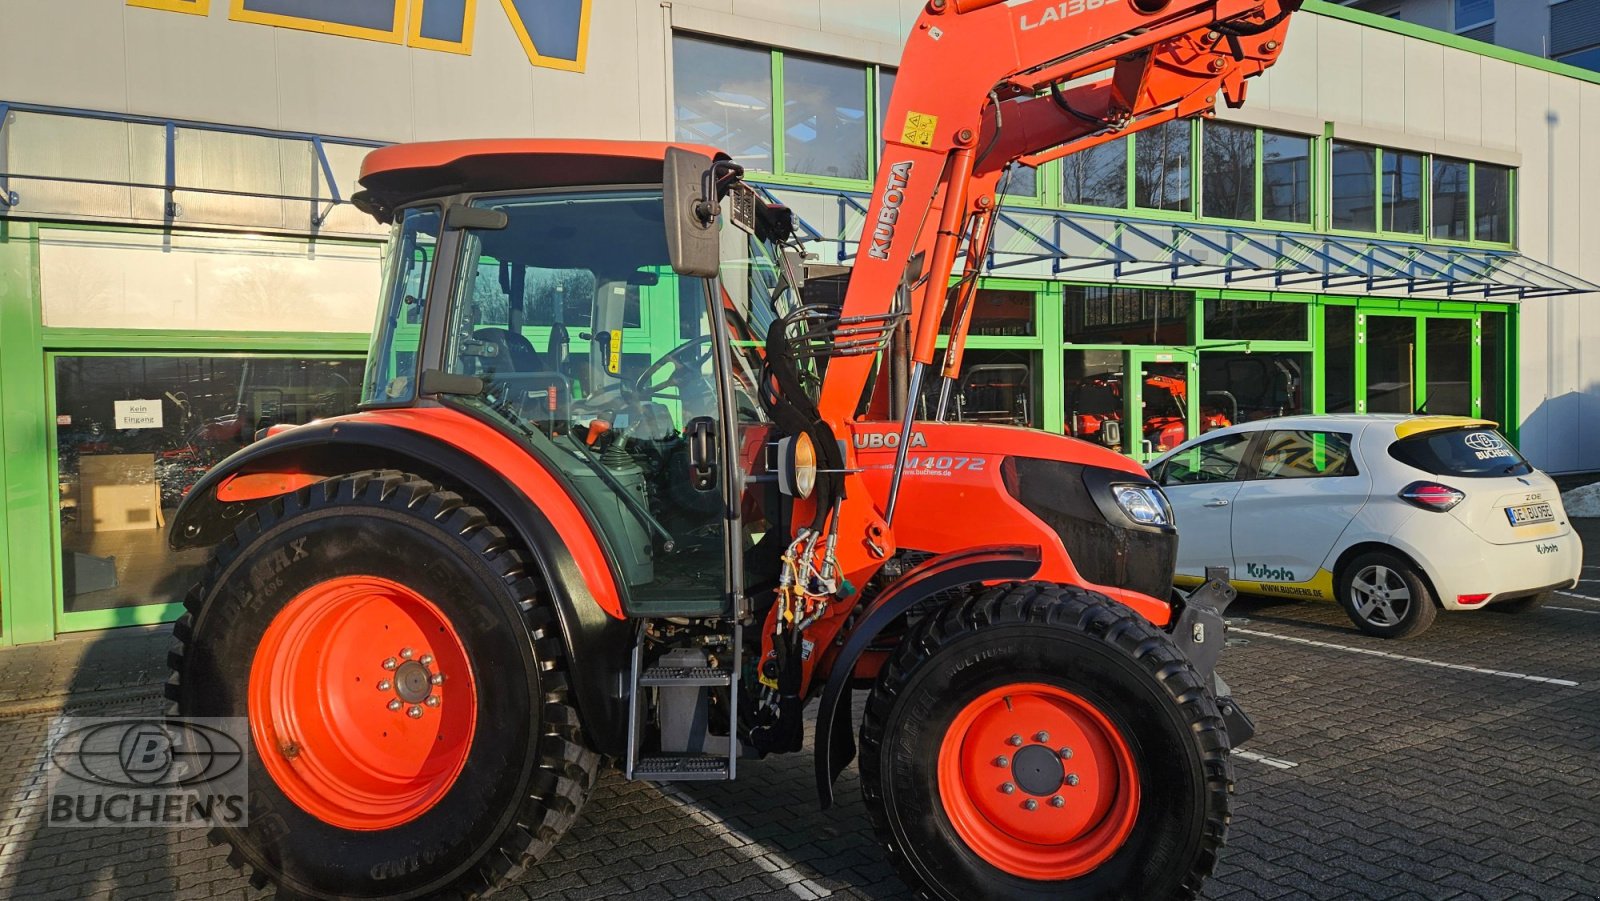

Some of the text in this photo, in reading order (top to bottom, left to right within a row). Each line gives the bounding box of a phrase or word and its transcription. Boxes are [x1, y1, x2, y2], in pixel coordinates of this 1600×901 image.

[869, 160, 915, 262] KUBOTA
[129, 404, 148, 413] Kein
[123, 416, 155, 424] Eingang
[853, 431, 928, 449] UBOA
[1247, 562, 1295, 581] Kubota
[1260, 583, 1323, 597] WWW.BUCHENS.DE
